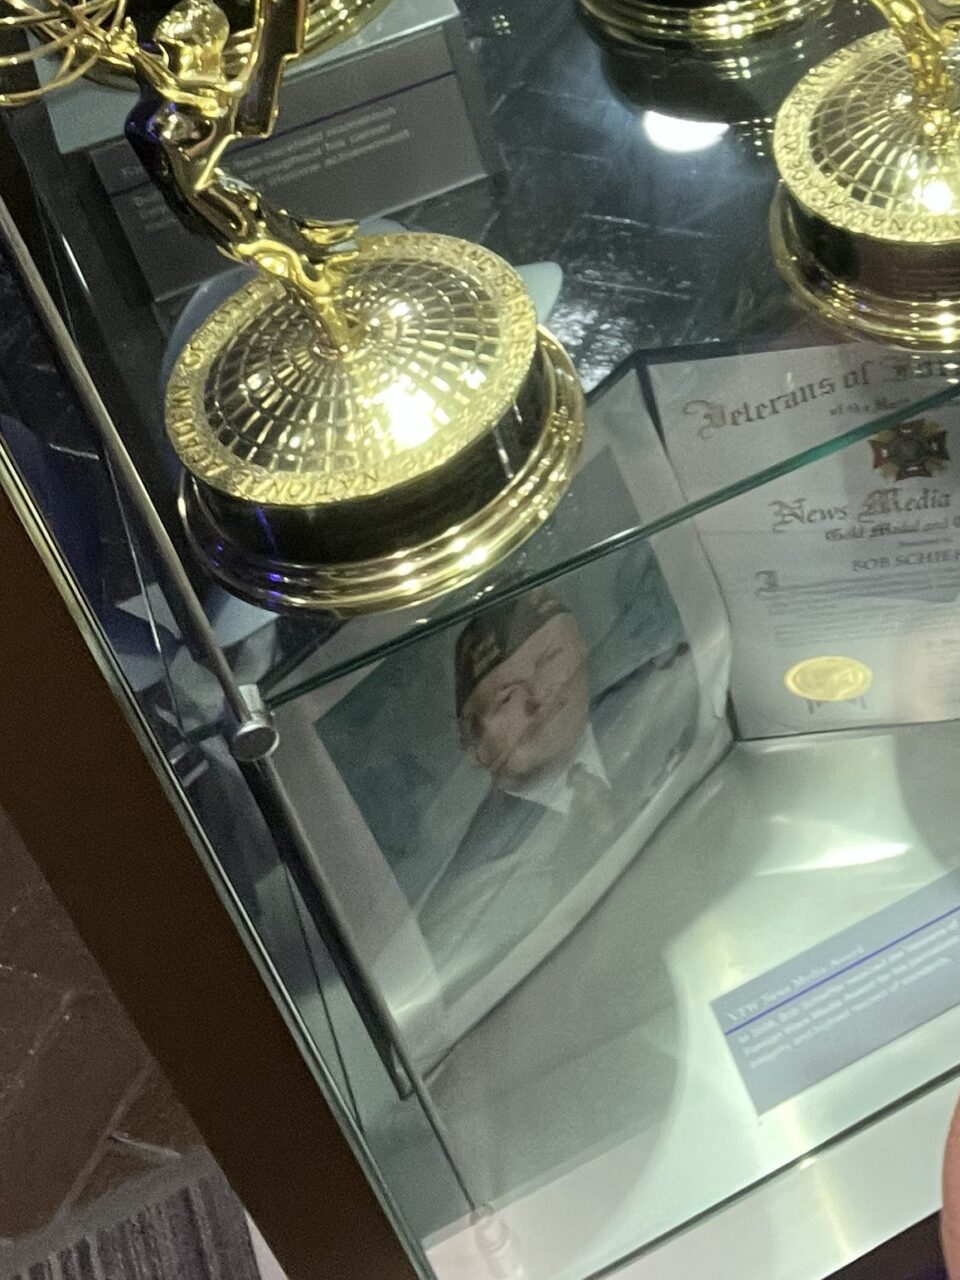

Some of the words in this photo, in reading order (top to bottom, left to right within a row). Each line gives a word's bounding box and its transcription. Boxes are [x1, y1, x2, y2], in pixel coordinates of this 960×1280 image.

[841, 359, 872, 389] of
[768, 497, 847, 533] News
[857, 488, 950, 523] Media
[851, 557, 890, 572] BOB
